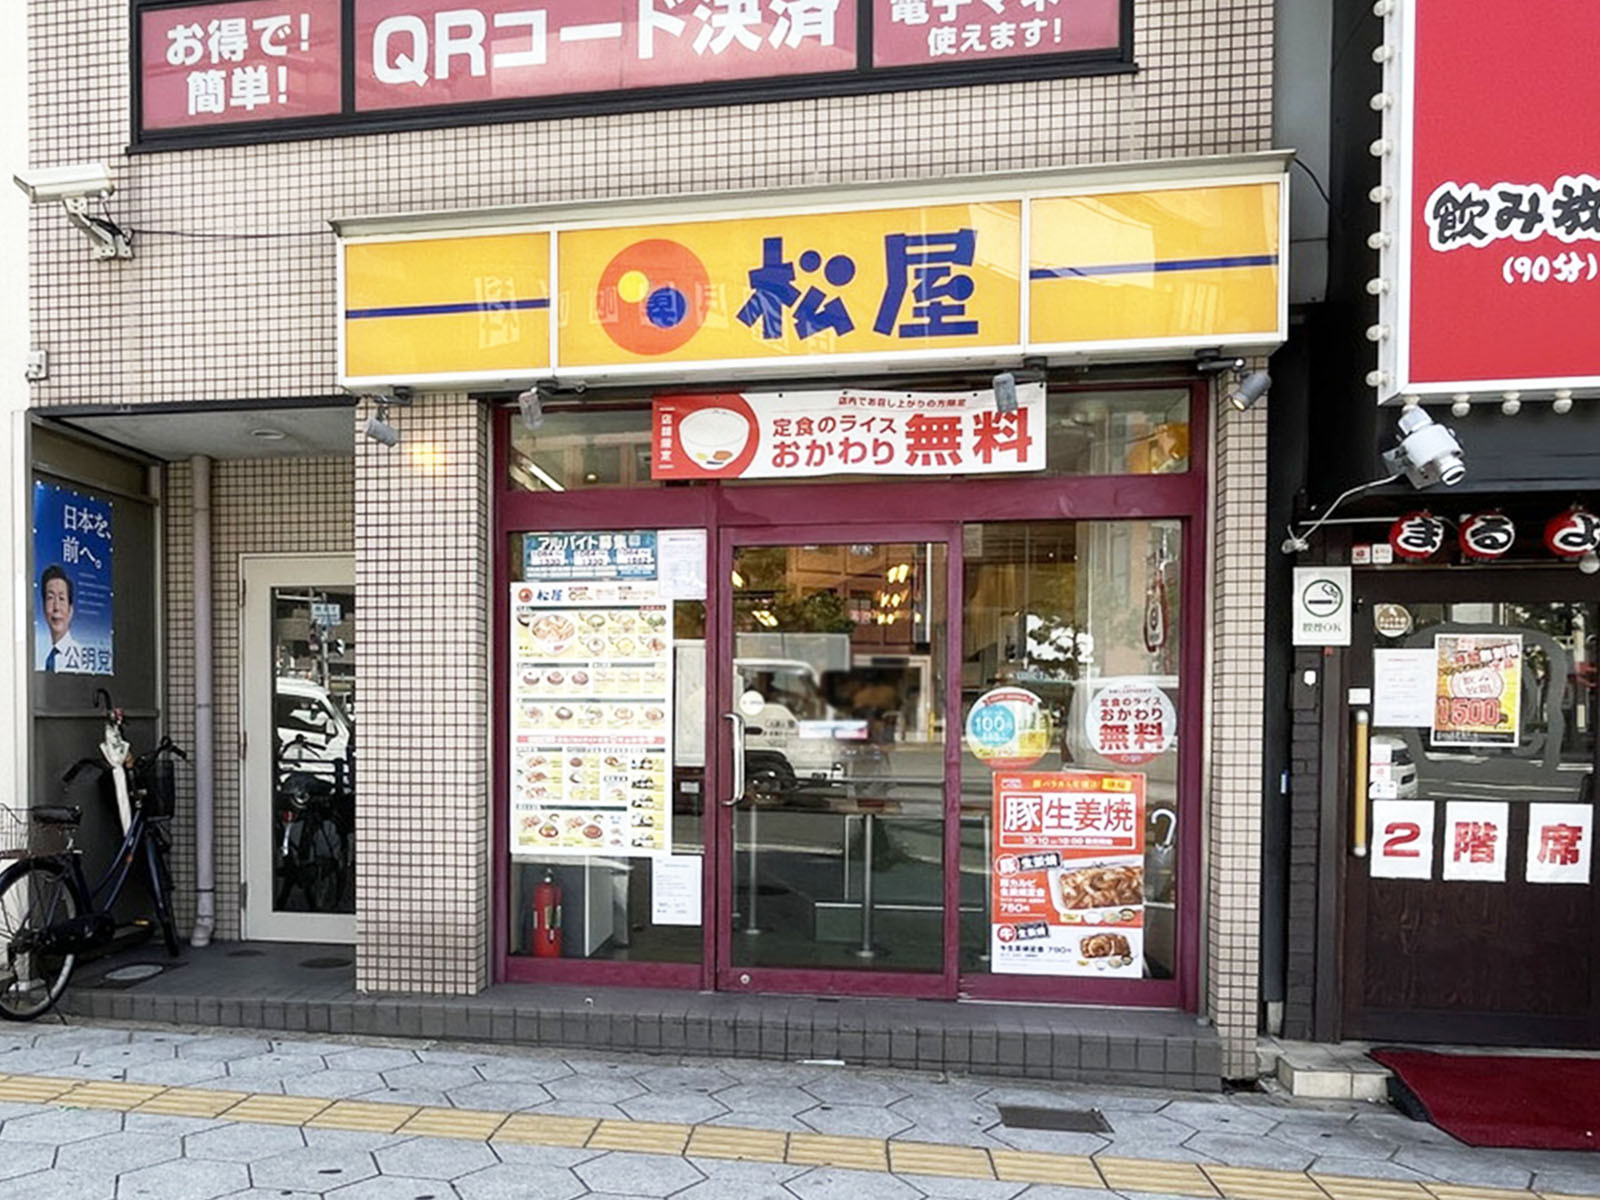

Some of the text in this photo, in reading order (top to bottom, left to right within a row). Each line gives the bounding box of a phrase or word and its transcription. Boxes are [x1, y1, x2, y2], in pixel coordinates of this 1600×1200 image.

[166, 13, 310, 65] お得で!
[372, 0, 839, 87] QRコード決済
[927, 18, 1062, 57] 使えます!
[186, 65, 288, 115] 簡単!
[736, 229, 978, 340] 松屋
[1502, 251, 1598, 284] (90分)
[772, 414, 898, 437] 定食のライス
[905, 406, 1033, 466] 無料
[772, 437, 895, 469] おかわり
[63, 504, 112, 540] 日本を、
[62, 535, 102, 570] 前へ。
[64, 645, 112, 673] 公明党
[1100, 697, 1162, 707] 定食のライス
[1101, 707, 1163, 722] おかわり
[1100, 722, 1164, 751] 無料
[1002, 795, 1134, 833] 豚生姜焼
